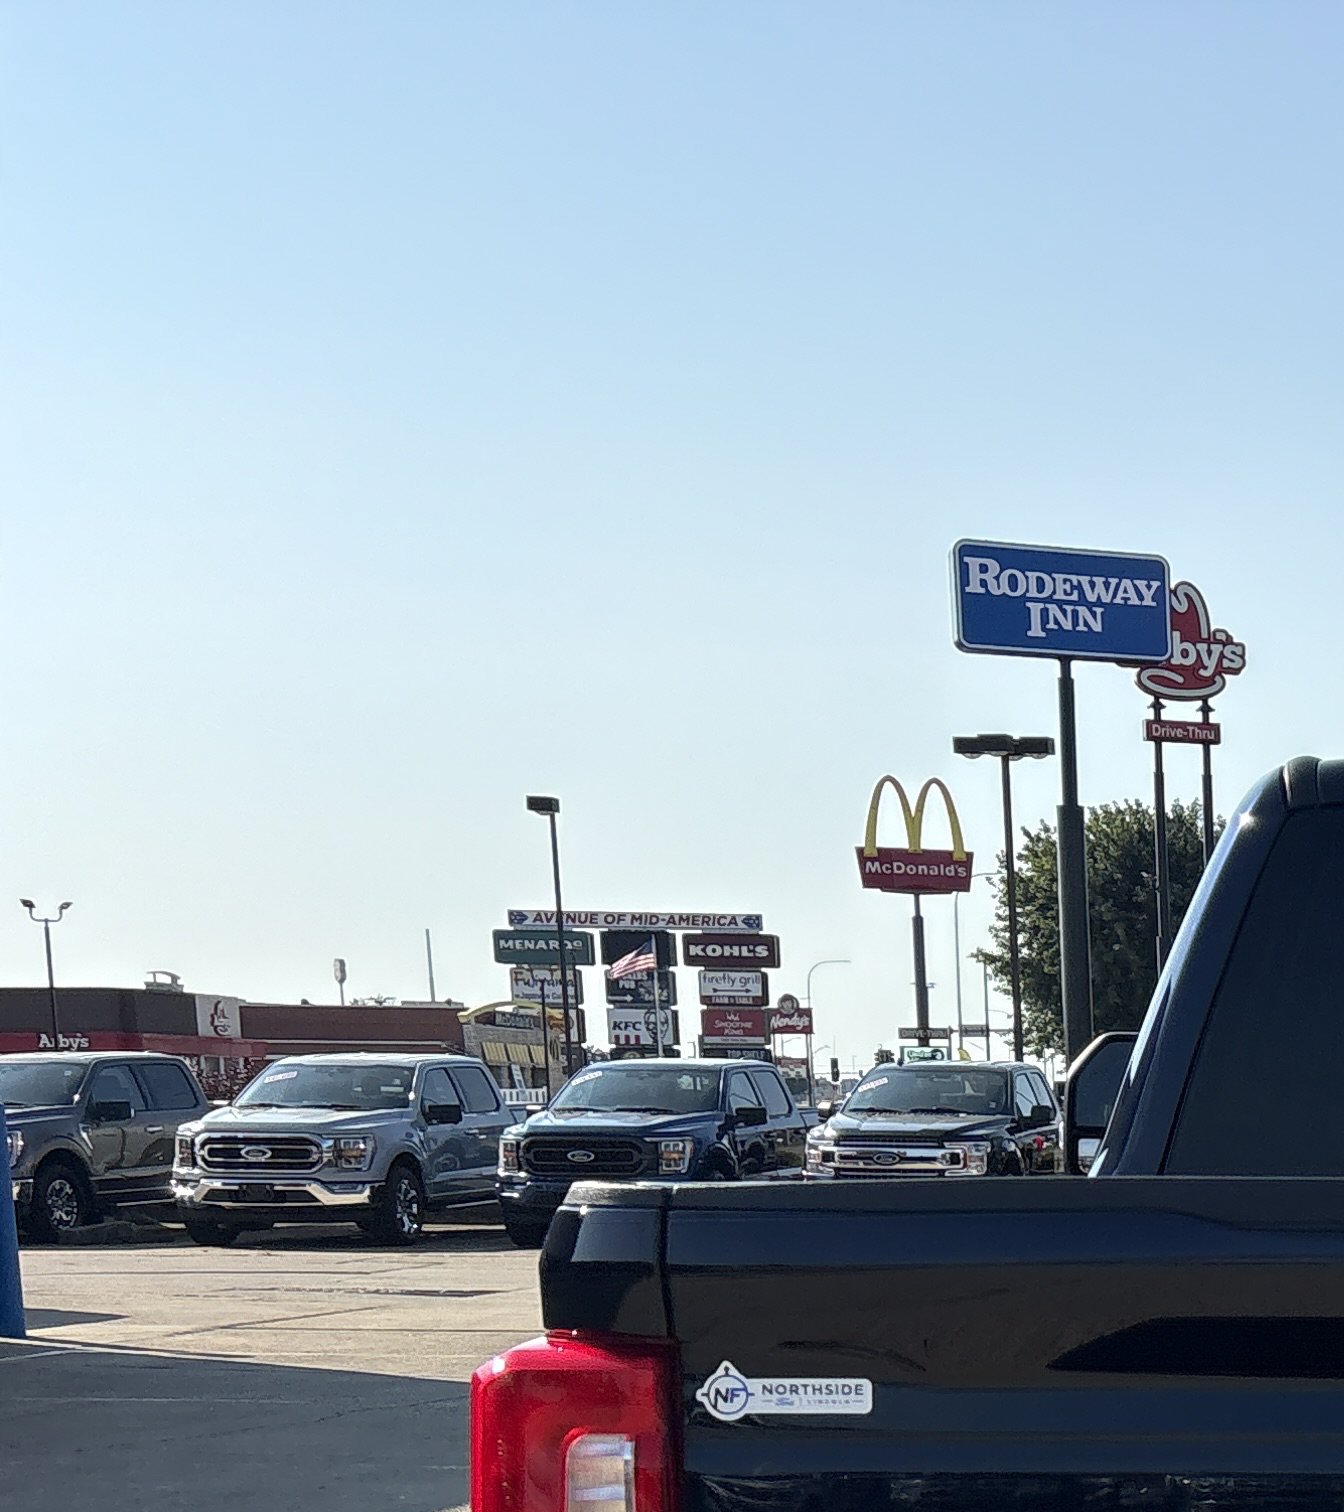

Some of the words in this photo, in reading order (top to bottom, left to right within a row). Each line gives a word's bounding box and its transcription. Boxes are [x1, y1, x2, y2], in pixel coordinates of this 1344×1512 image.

[1025, 602, 1105, 638] INN
[1169, 629, 1245, 678] by's
[1151, 723, 1216, 740] Drive-Thru
[864, 860, 968, 878] McDonald's
[532, 911, 599, 925] AVNUE
[603, 912, 627, 925] OF
[630, 913, 739, 927] MID-AMERICA
[688, 944, 769, 958] KOHL'S
[611, 1020, 643, 1031] KFC
[761, 1383, 865, 1396] NORTHSIDE
